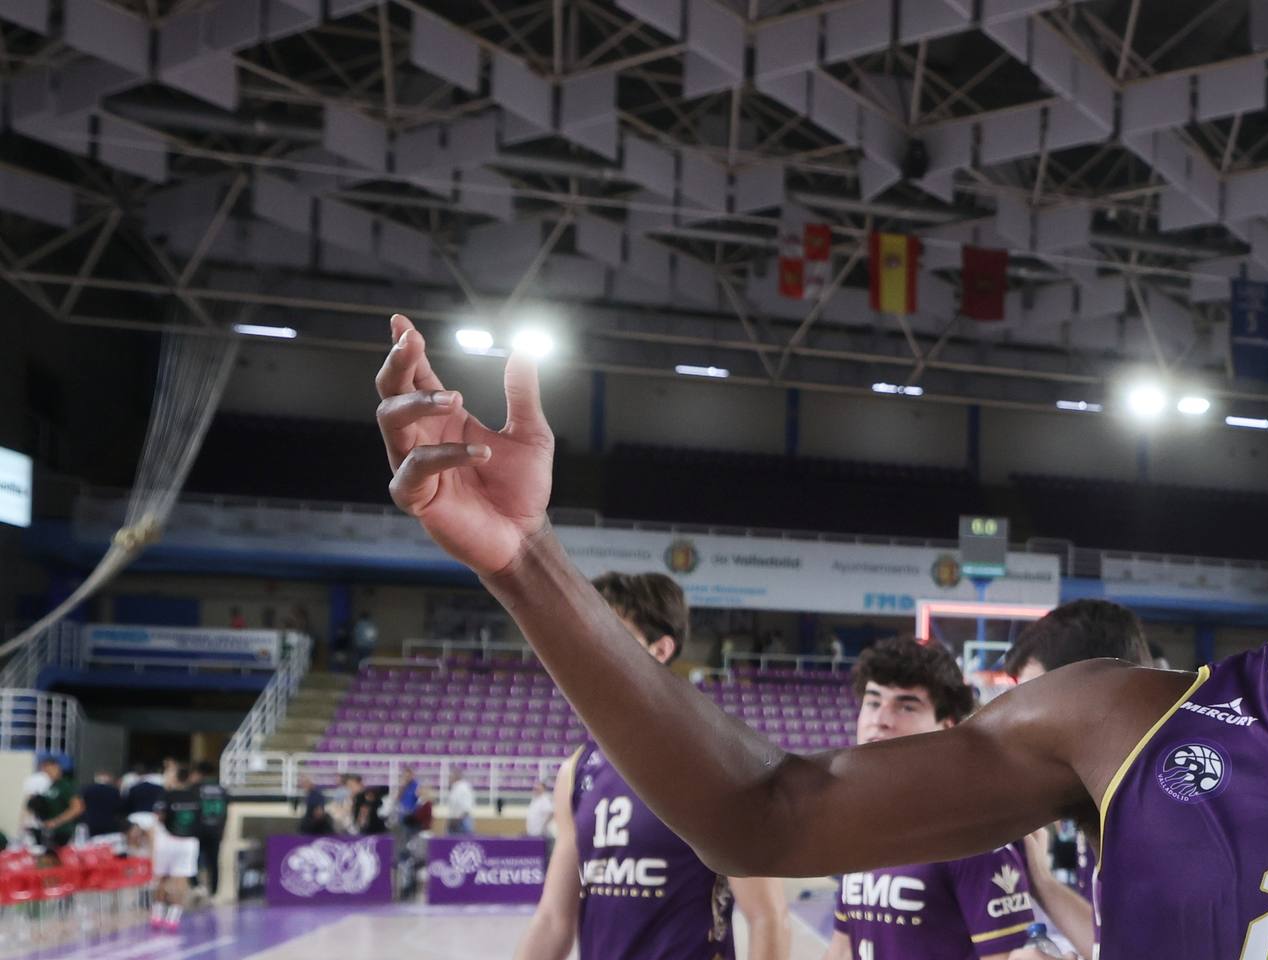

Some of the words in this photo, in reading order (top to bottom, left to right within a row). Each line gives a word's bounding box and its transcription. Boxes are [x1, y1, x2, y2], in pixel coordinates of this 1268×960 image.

[1180, 701, 1259, 727] MERCURY
[1158, 774, 1190, 802] VALLADOLID
[593, 796, 633, 848] 12
[475, 868, 545, 885] ACEVES
[842, 872, 926, 911] EMC
